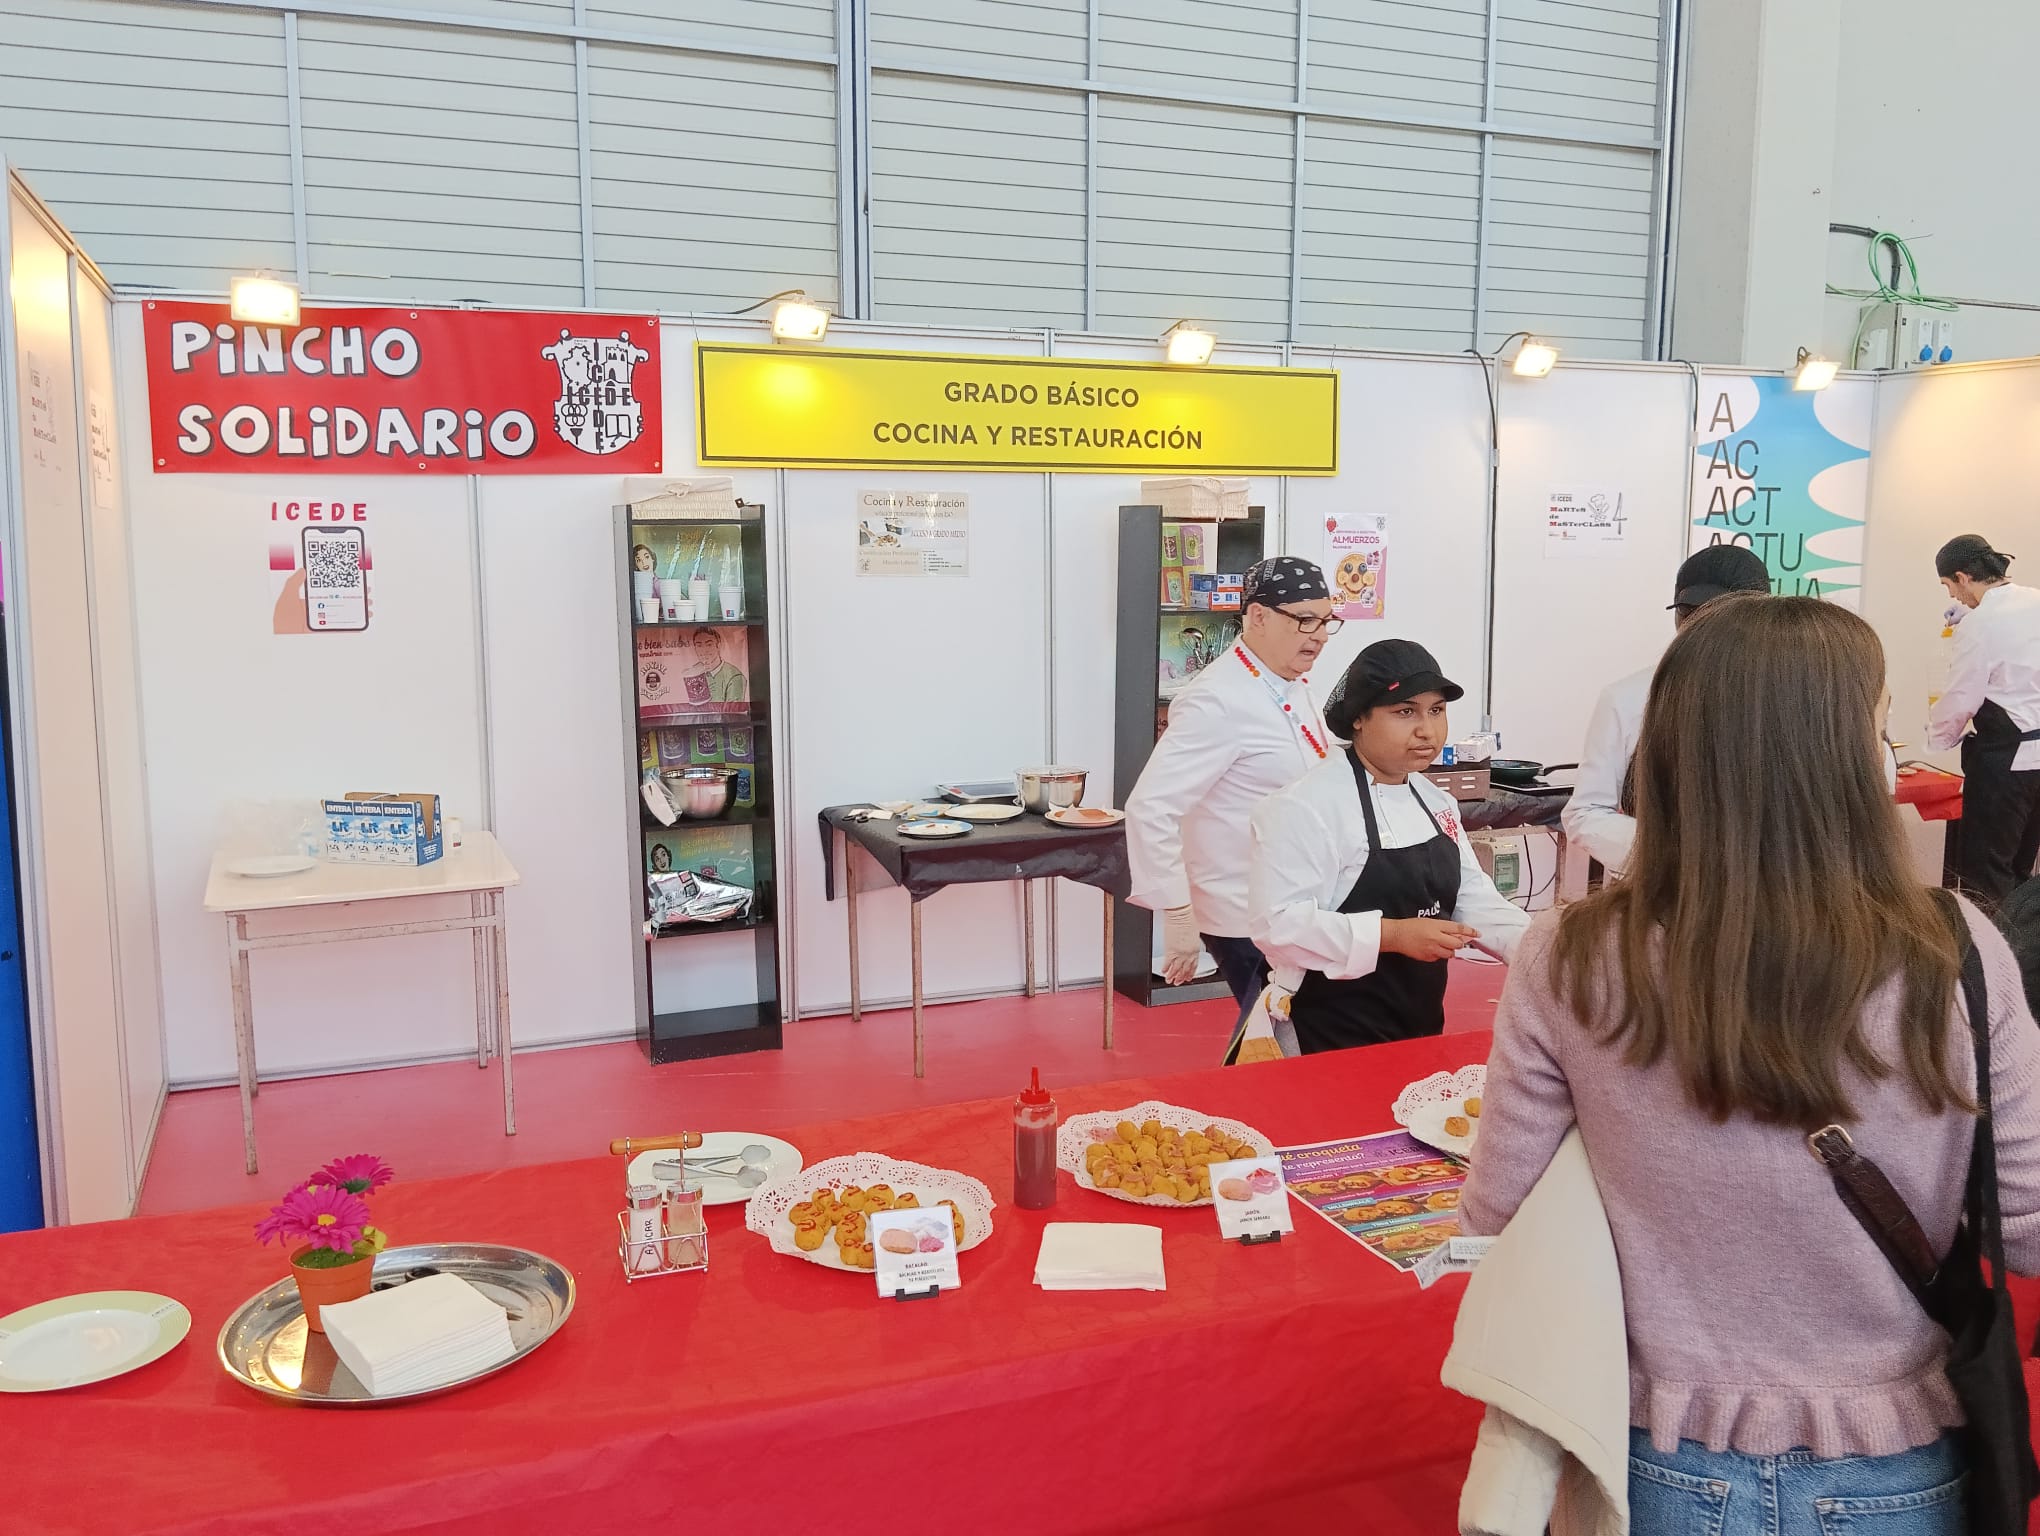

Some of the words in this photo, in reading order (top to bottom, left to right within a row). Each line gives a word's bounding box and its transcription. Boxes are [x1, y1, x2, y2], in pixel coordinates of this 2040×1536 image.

[567, 386, 631, 406] ICEDE
[944, 381, 1038, 404] GRADO
[1047, 381, 1139, 408] BÁSICO
[1709, 392, 1735, 432] A
[874, 422, 978, 445] COCINA
[987, 425, 1002, 446] Y
[1011, 425, 1202, 450] RESTAURACIÓN
[1706, 440, 1760, 480] AC
[271, 502, 367, 521] ICEDE
[1703, 486, 1781, 526] ACT
[1332, 536, 1380, 544] ALMUERZOS
[326, 805, 353, 813] ENTERA
[355, 806, 381, 814] ENTERA
[384, 807, 412, 815] ENTERA
[1296, 1153, 1365, 1169] representa?
[1297, 1144, 1363, 1159] croqueta
